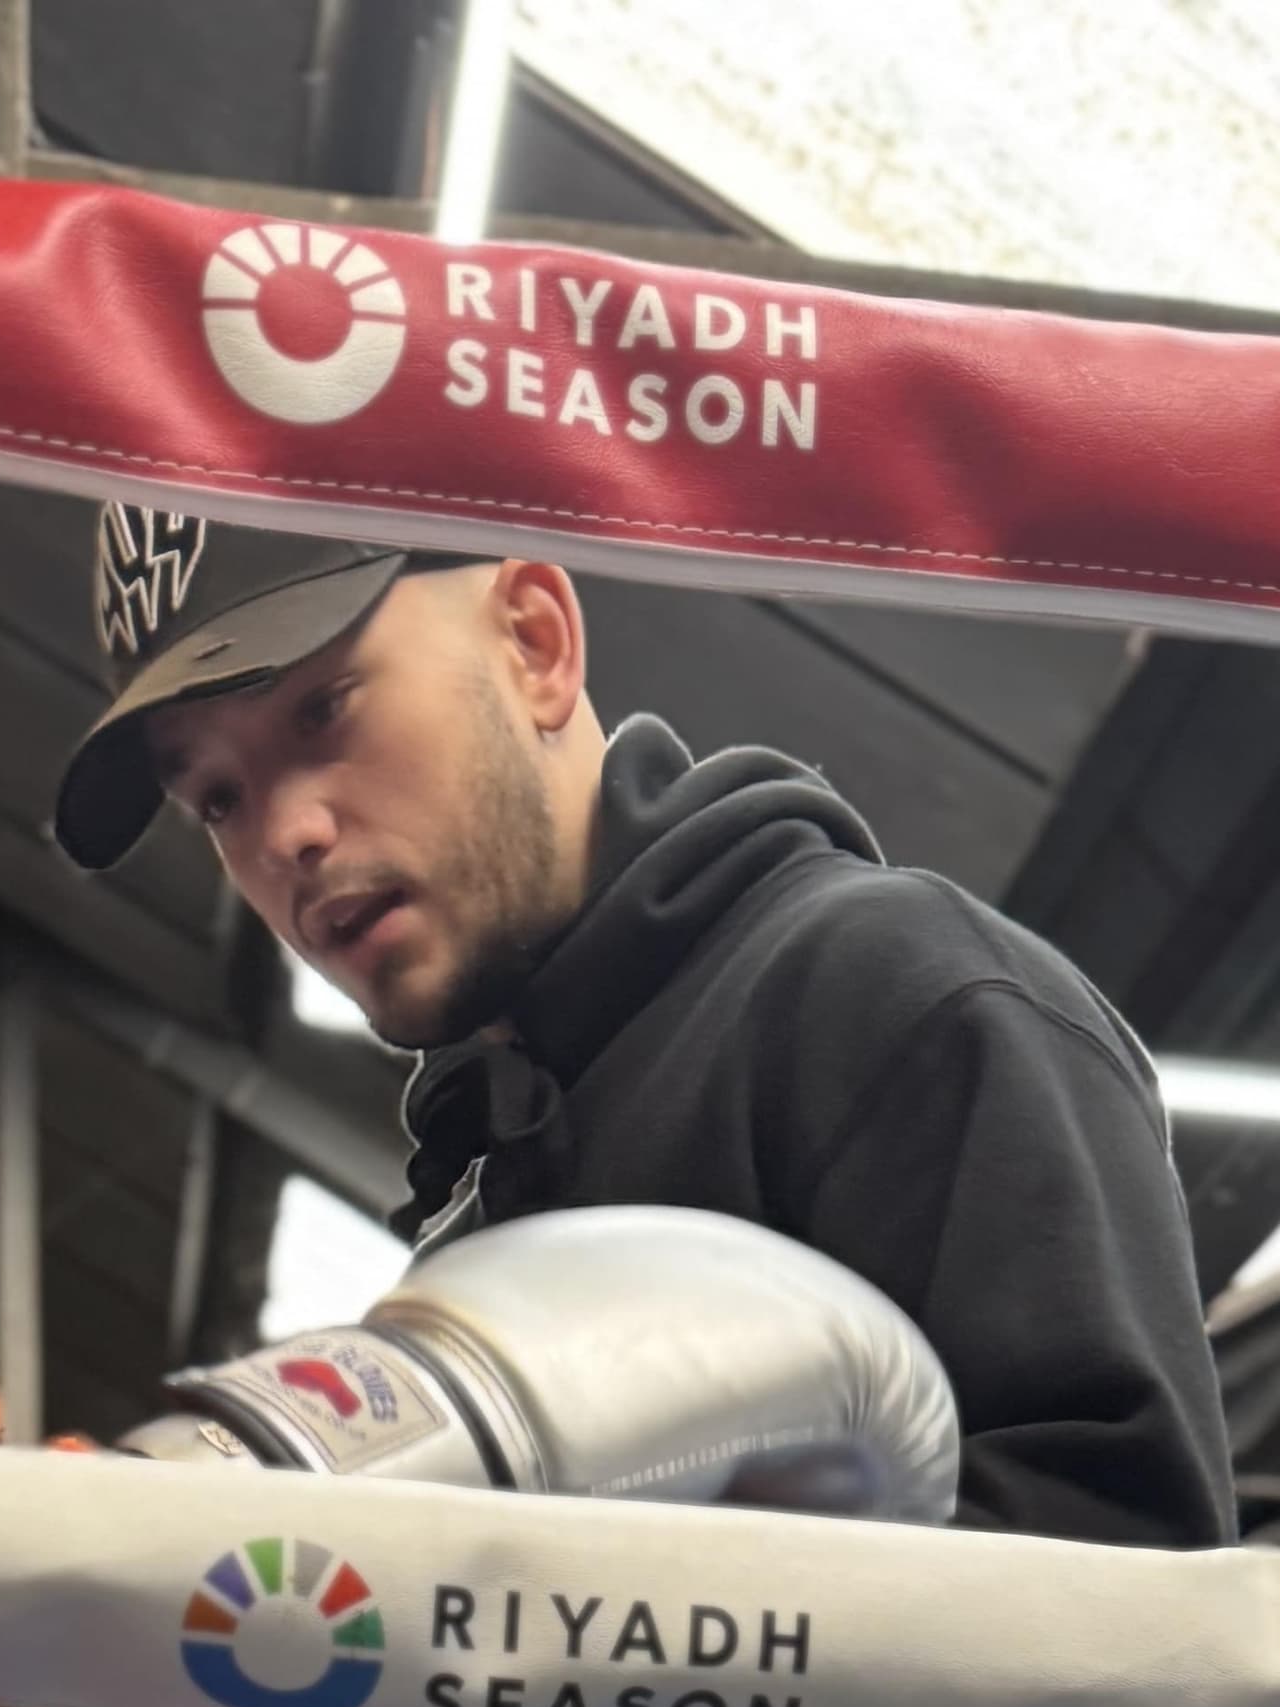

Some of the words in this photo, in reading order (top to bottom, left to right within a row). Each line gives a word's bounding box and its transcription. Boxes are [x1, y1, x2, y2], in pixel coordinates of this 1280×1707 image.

[445, 263, 817, 359] RIYADH
[444, 338, 817, 450] SEASON
[431, 1584, 811, 1675] RIYADH
